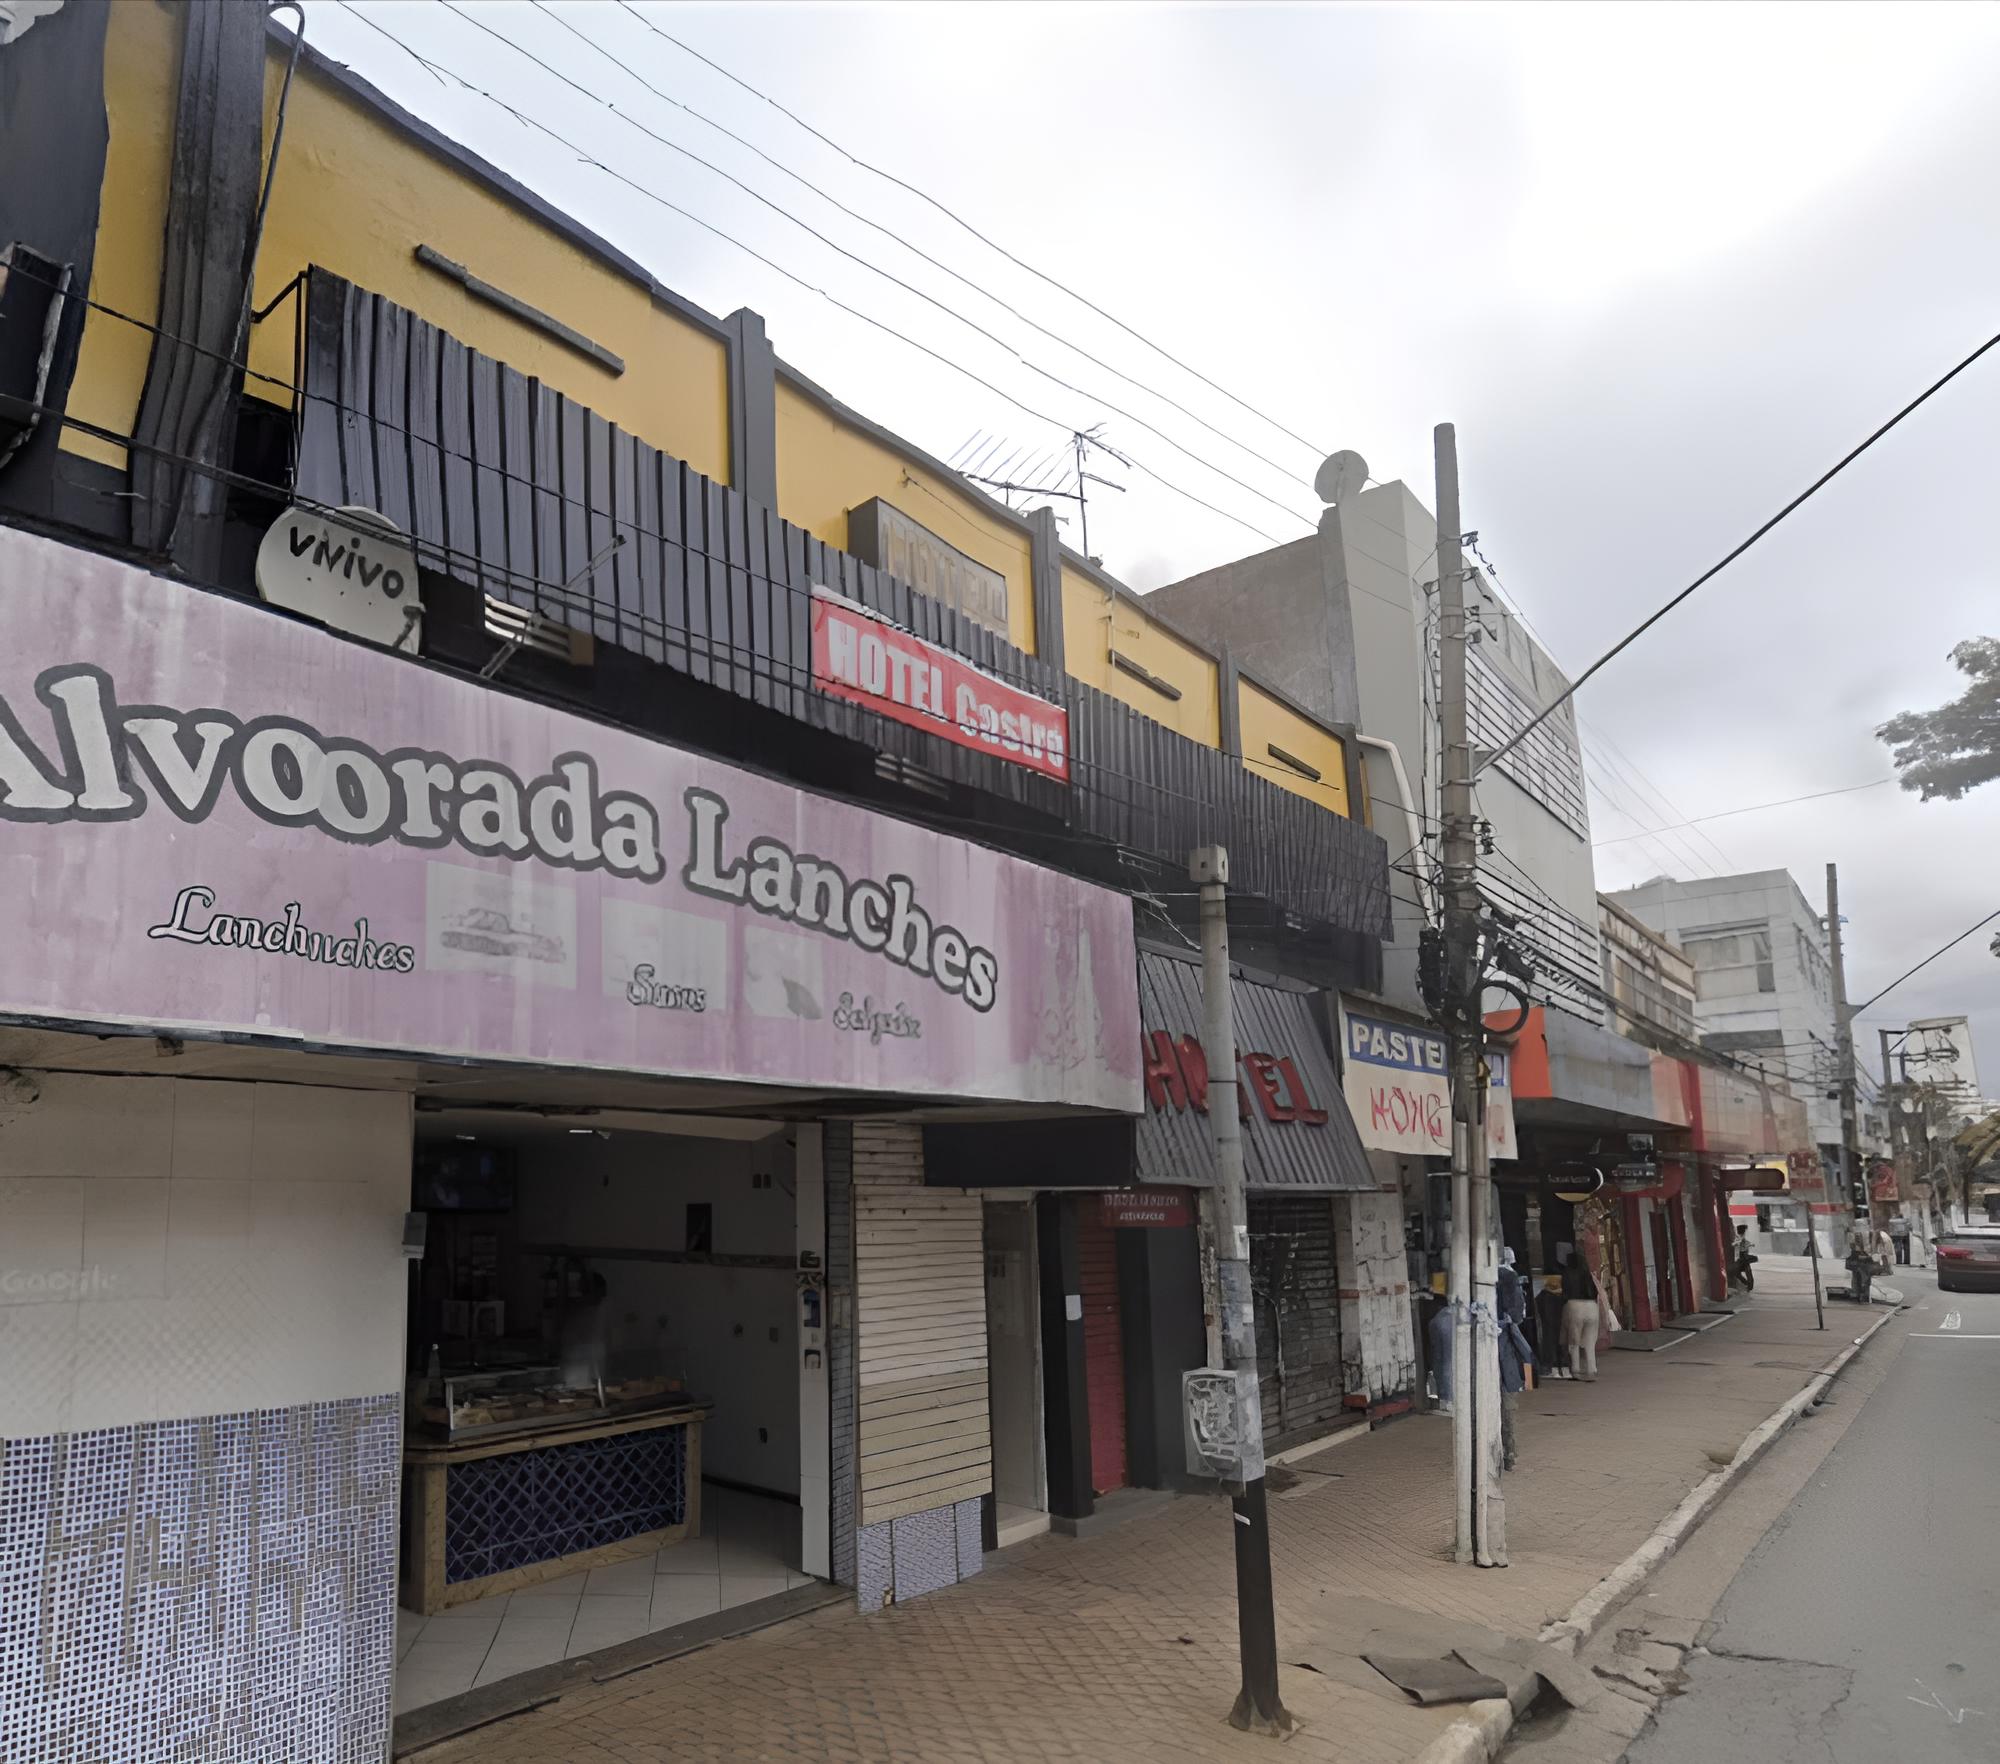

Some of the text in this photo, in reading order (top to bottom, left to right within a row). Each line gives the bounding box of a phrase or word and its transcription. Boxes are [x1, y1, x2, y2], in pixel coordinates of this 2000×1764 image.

[827, 615, 1065, 769] HOTEL Castro
[683, 786, 999, 1012] Lanches
[1141, 1030, 1328, 1126] HOEL
